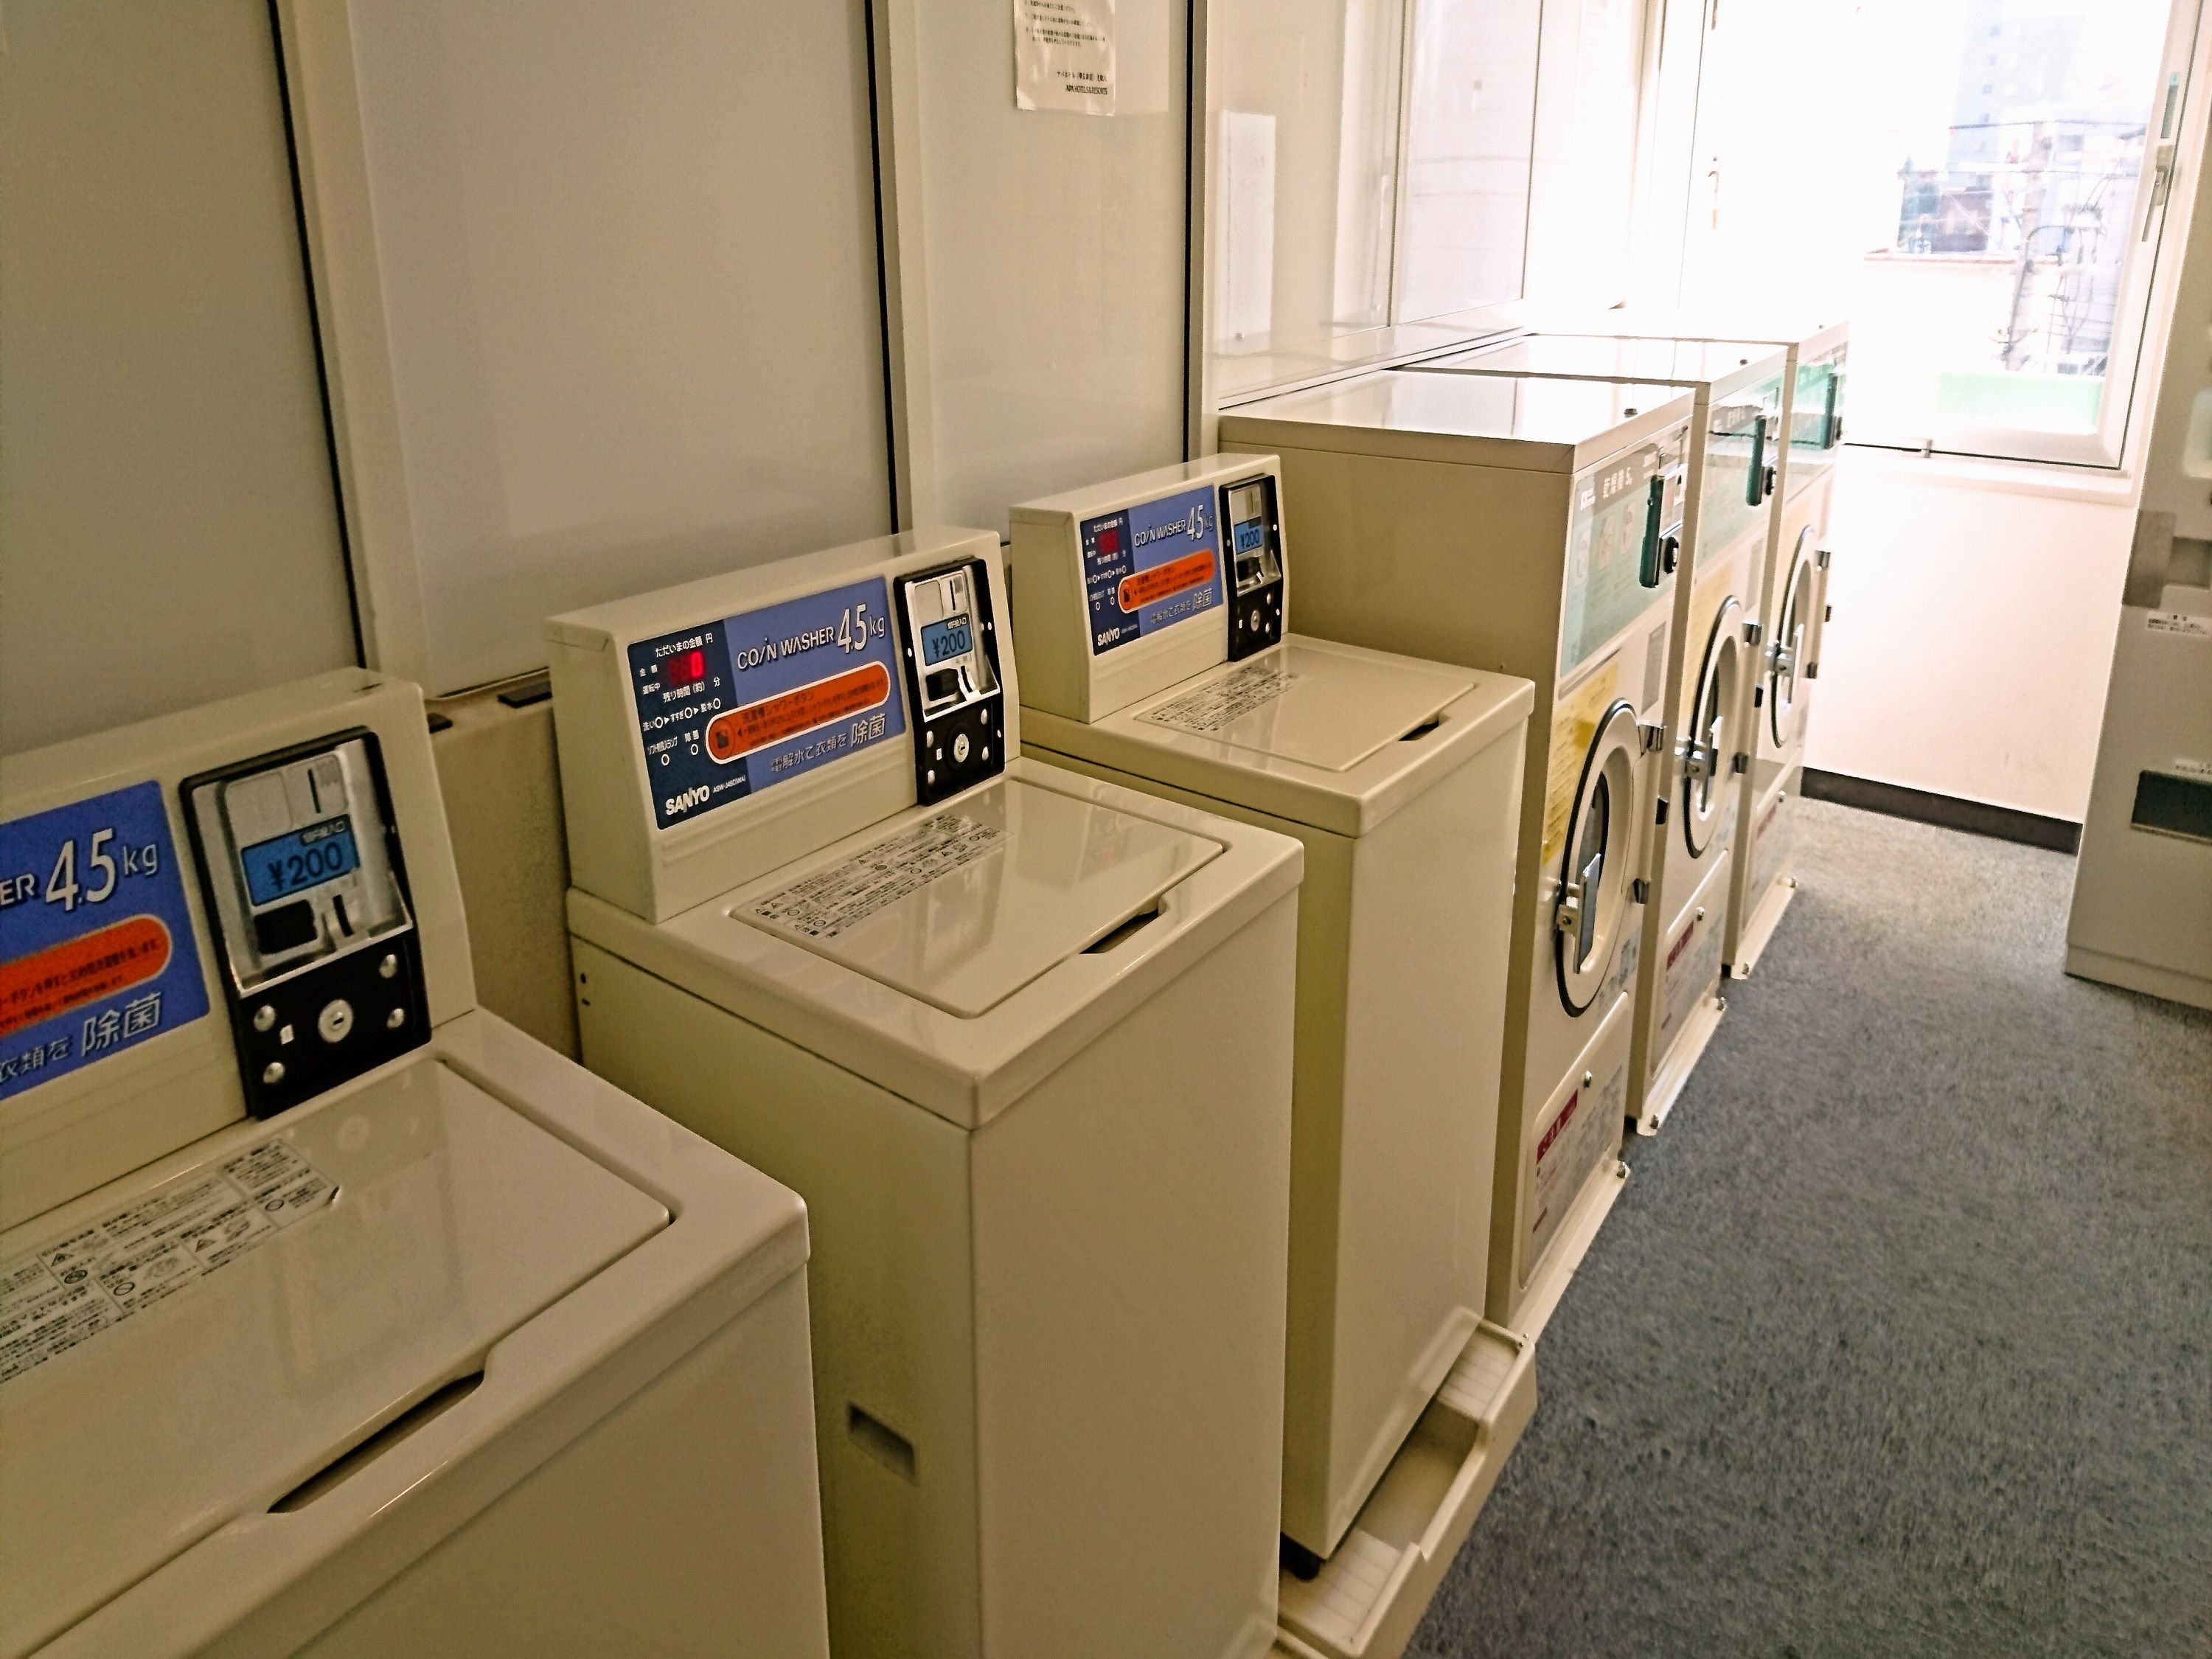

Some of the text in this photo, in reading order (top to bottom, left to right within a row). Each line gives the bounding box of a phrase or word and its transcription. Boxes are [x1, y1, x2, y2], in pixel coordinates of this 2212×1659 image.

[1156, 519, 1186, 539] WASHER
[1239, 529, 1260, 550] ¥200
[780, 626, 835, 656] WASHER
[932, 630, 965, 659] ¥200
[1097, 627, 1120, 647] SANYO
[849, 712, 886, 748] 除菌
[665, 785, 710, 816] SANYO
[267, 841, 343, 892] ¥200
[81, 991, 162, 1057] 除菌
